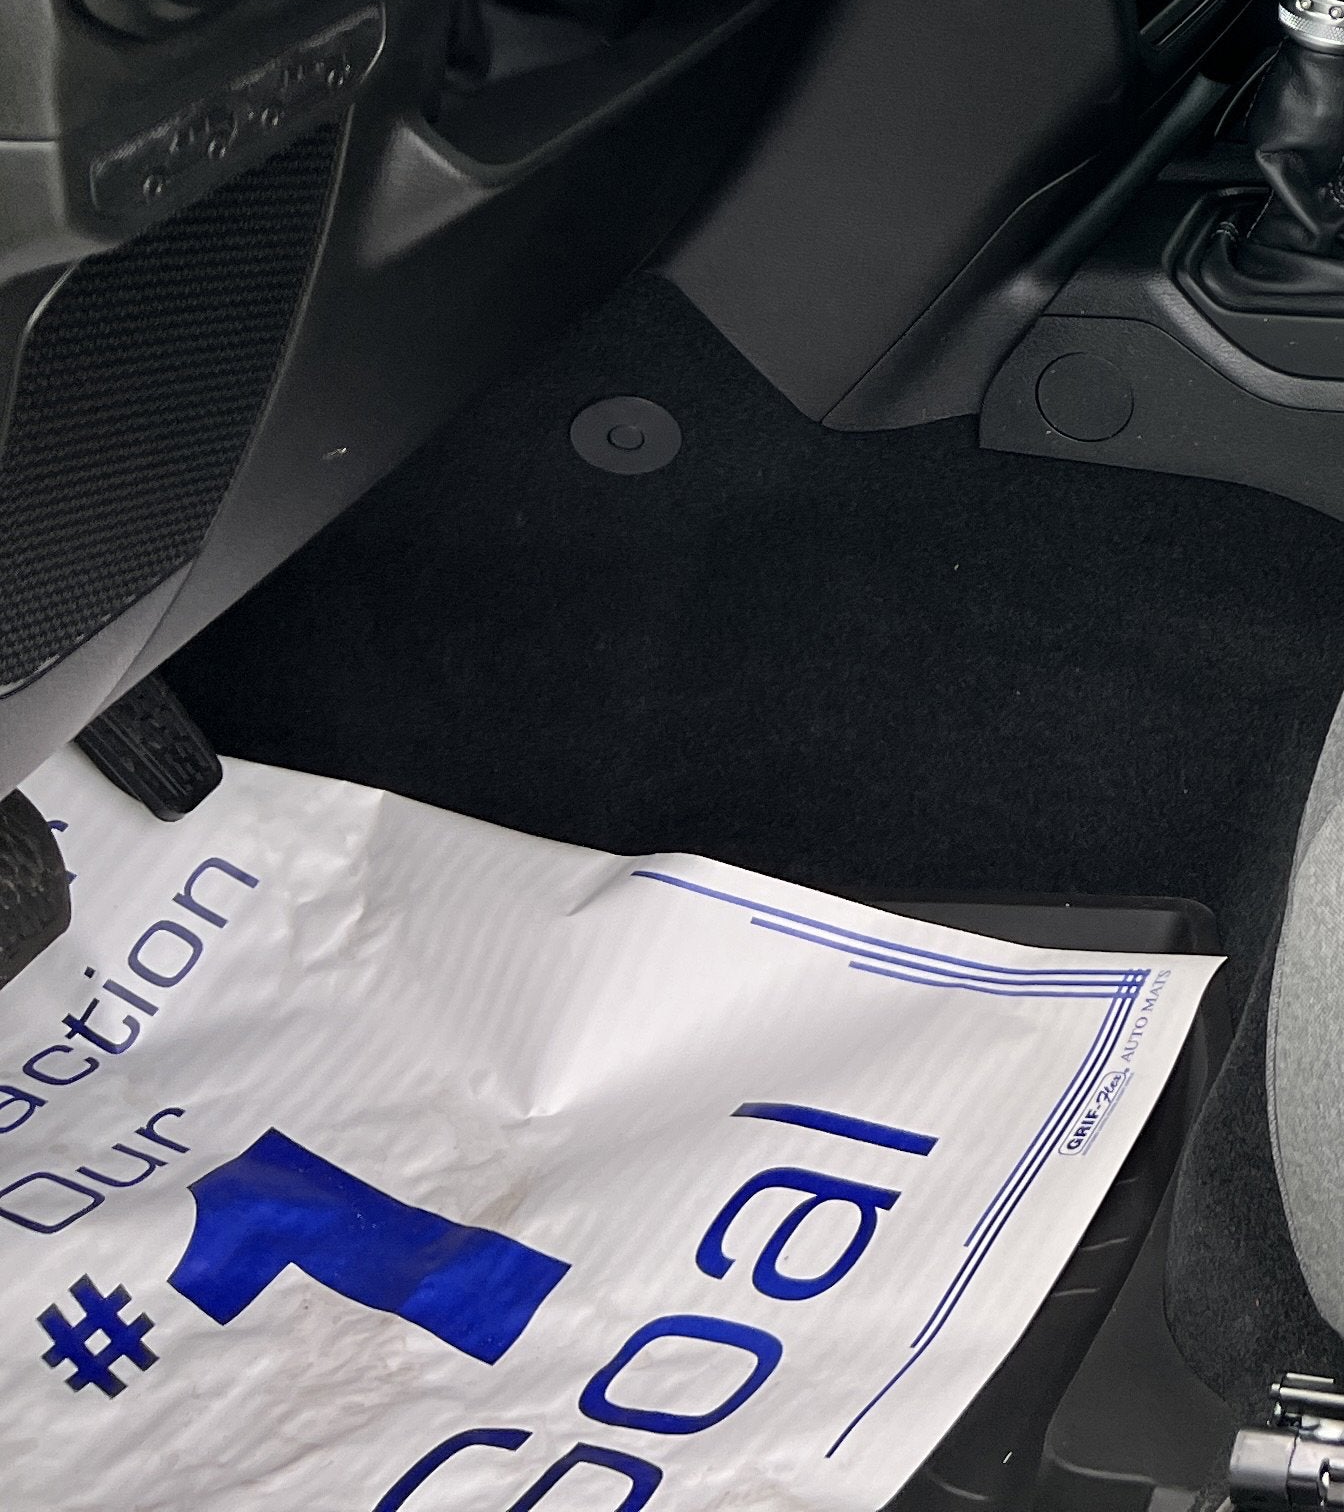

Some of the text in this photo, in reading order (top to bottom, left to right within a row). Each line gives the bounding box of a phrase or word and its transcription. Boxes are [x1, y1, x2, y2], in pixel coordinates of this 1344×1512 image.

[1120, 1017, 1149, 1063] AUTO
[1141, 969, 1172, 1014] MATS
[0, 1106, 191, 1235] Our
